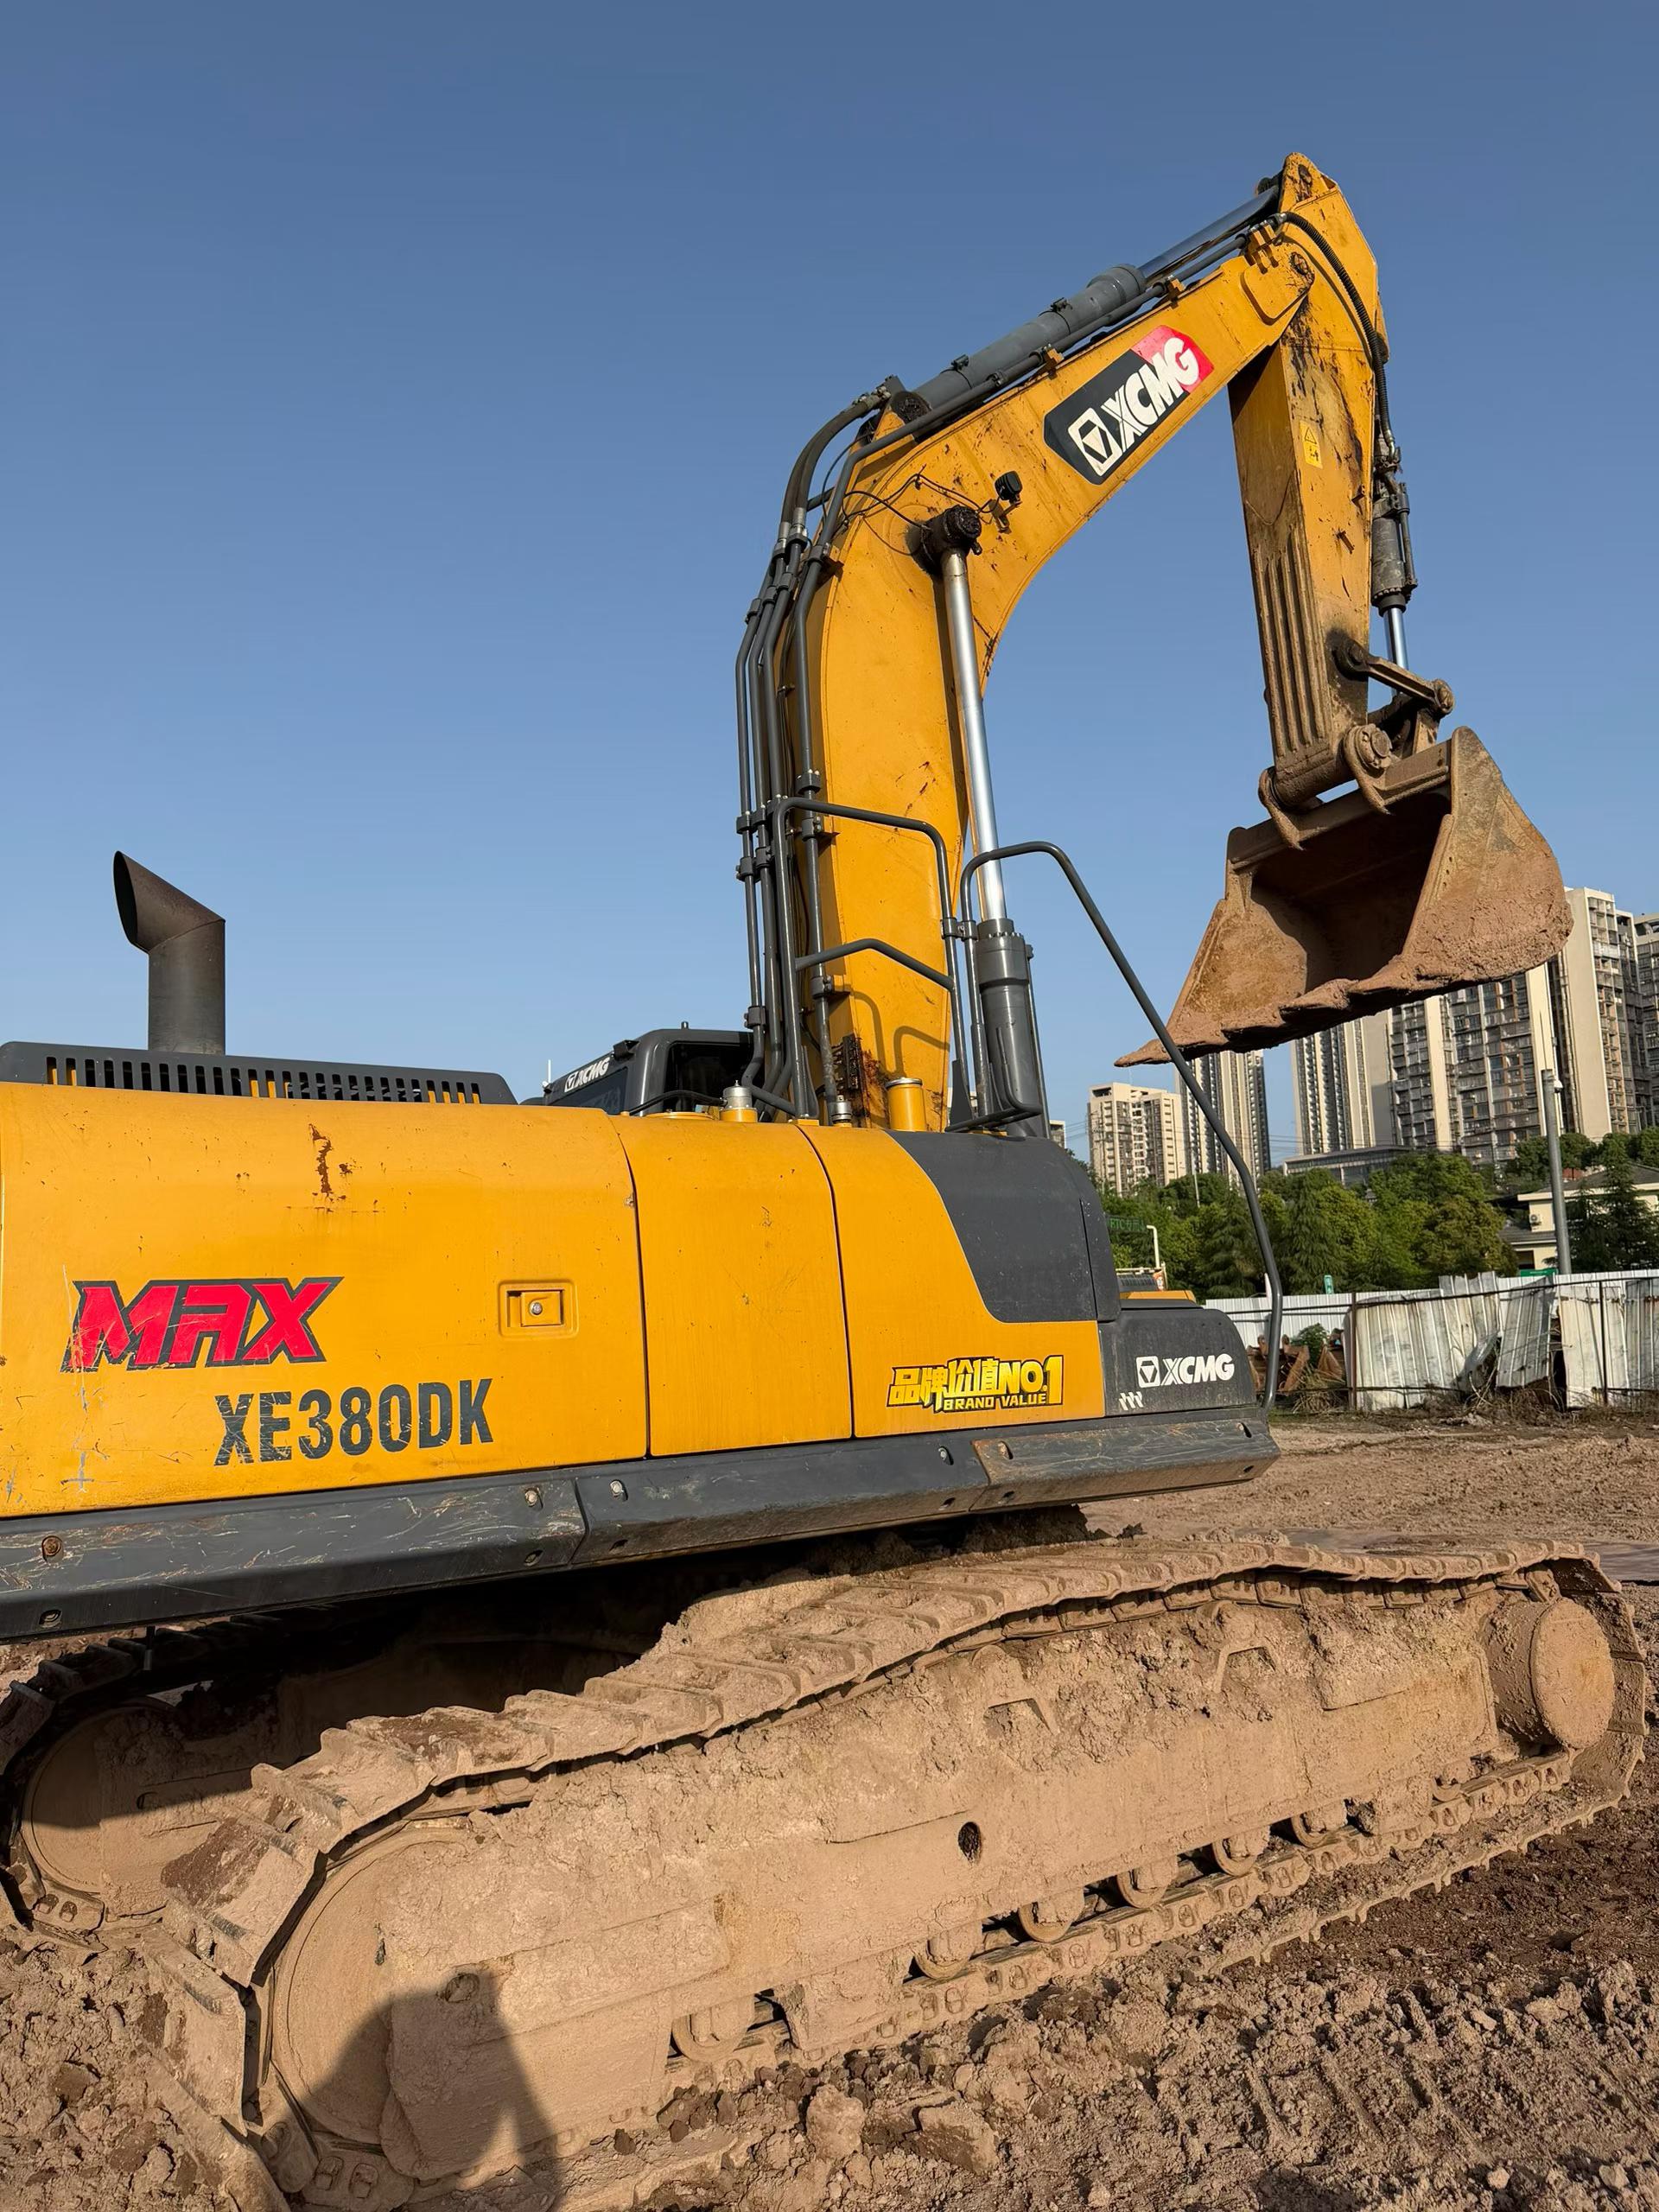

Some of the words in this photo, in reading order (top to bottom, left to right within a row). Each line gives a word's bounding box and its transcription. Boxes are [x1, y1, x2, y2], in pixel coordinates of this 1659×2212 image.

[1101, 337, 1199, 453] XCMG
[60, 1276, 344, 1372] MAX
[943, 1396, 995, 1410] BRAND
[998, 1393, 1047, 1407] VALUE
[1160, 1353, 1235, 1386] XCMG
[214, 1378, 493, 1466] XE380DK
